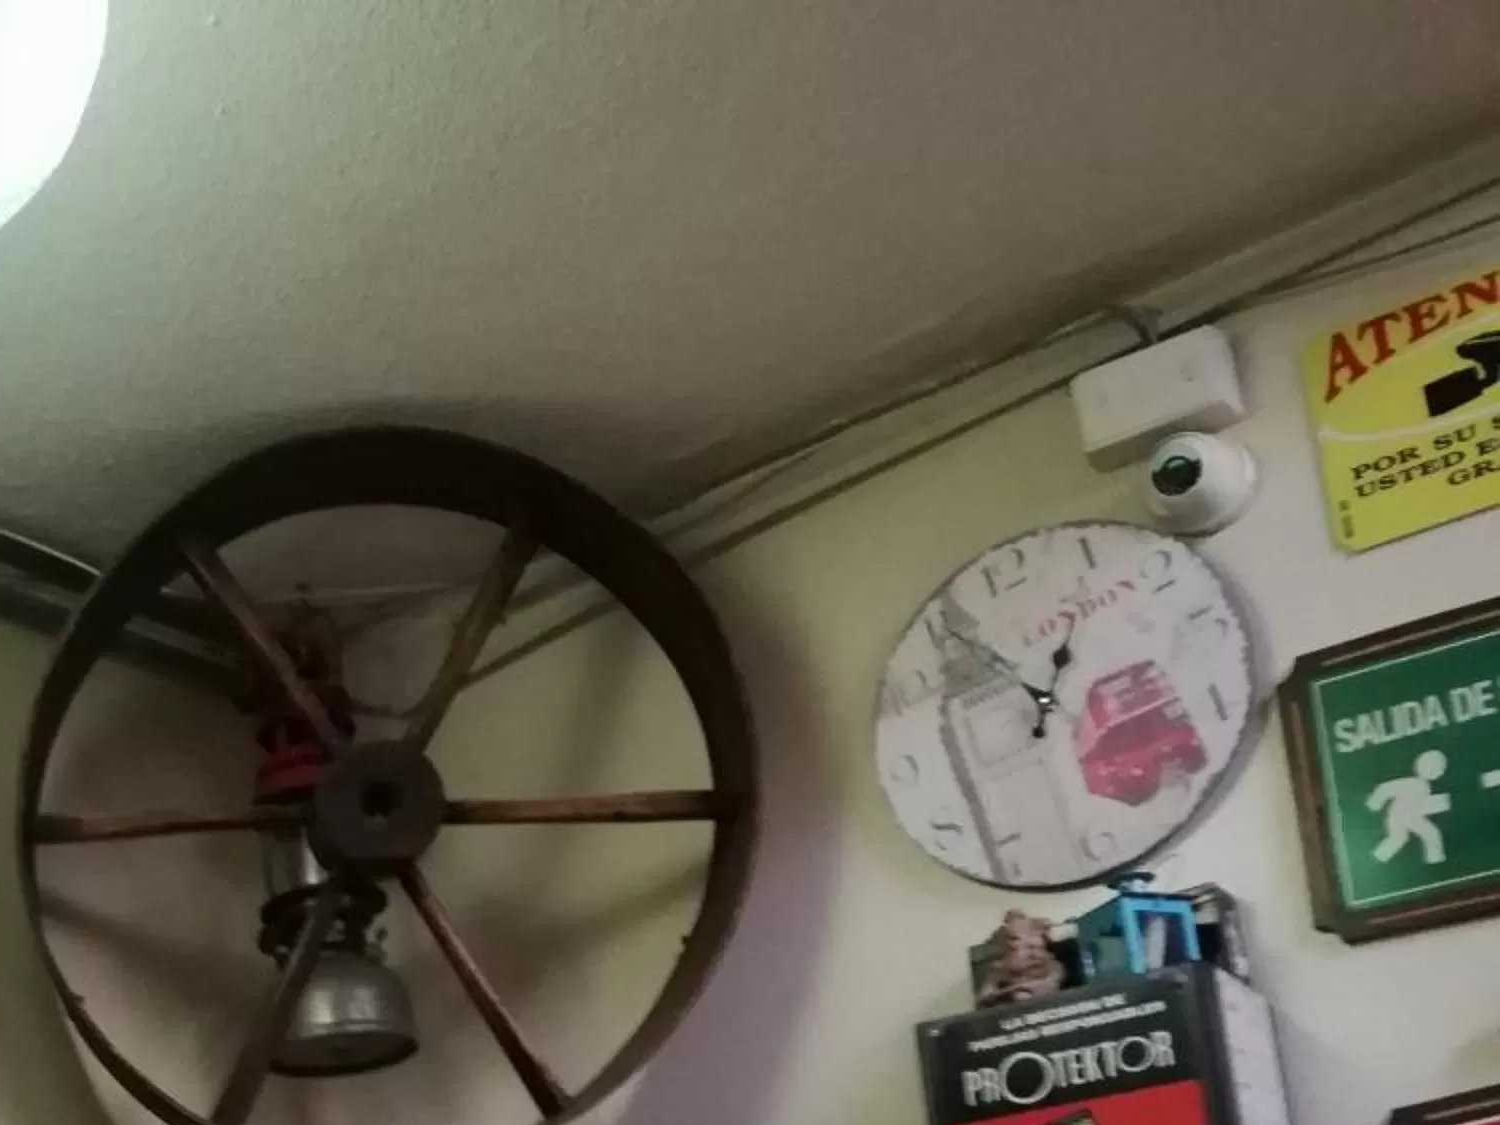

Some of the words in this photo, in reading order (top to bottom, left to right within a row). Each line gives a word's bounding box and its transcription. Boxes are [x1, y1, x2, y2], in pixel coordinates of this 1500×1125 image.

[1324, 269, 1500, 405] ATEN
[1352, 446, 1421, 482] POR
[1432, 423, 1477, 451] SU
[1355, 450, 1466, 498] USTED
[1447, 459, 1500, 486] GR
[1333, 695, 1450, 753] SALIDA
[1448, 679, 1498, 724] DE
[961, 1030, 1177, 1106] PROTEKTOR
